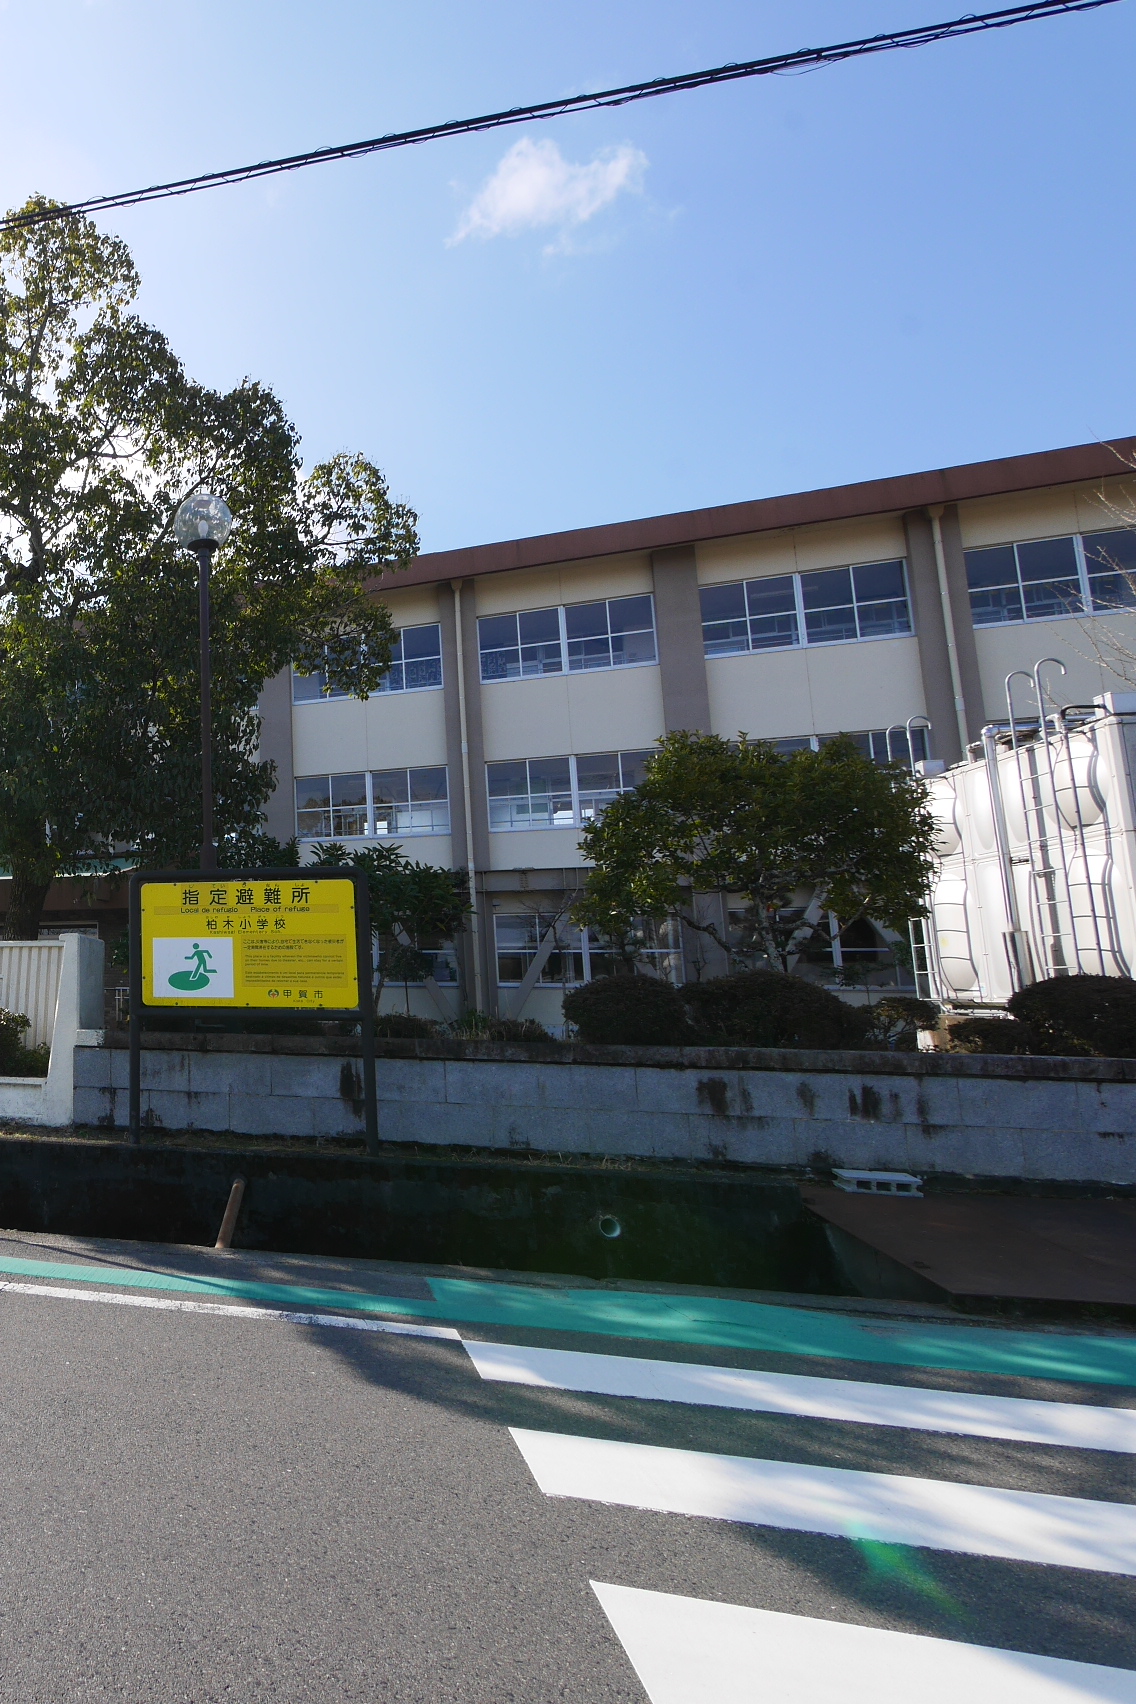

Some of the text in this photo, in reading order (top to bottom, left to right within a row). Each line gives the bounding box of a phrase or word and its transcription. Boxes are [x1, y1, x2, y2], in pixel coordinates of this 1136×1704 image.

[182, 886, 310, 906] 指定避難所
[212, 906, 239, 914] refugio
[284, 905, 310, 913] refuge
[206, 918, 287, 931] 柏木小学校
[283, 989, 323, 999] 甲賀市
